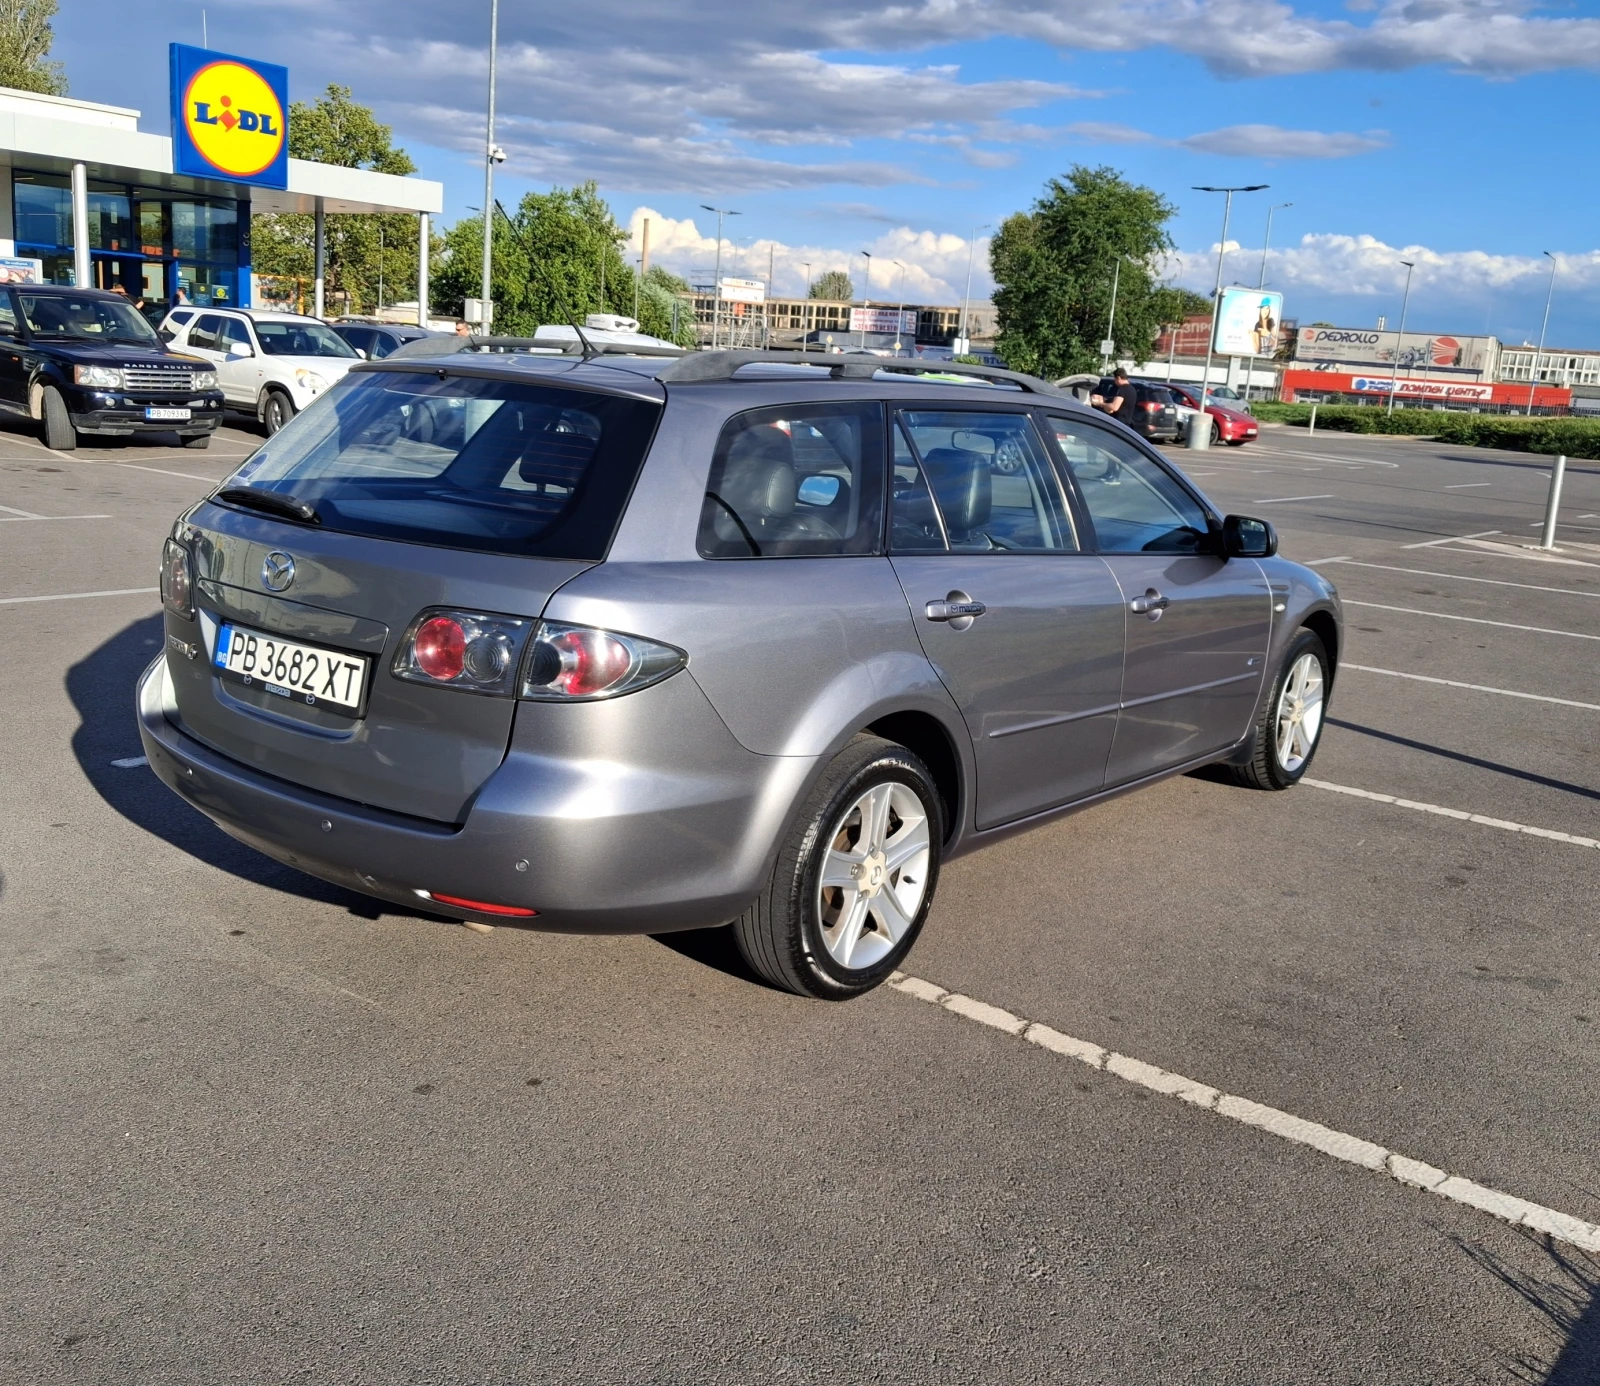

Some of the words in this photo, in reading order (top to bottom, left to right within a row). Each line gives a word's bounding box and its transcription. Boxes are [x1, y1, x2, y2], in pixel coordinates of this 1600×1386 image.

[1314, 331, 1379, 344] PEDROLLO
[216, 651, 228, 663] BG
[260, 641, 319, 692] 3682
